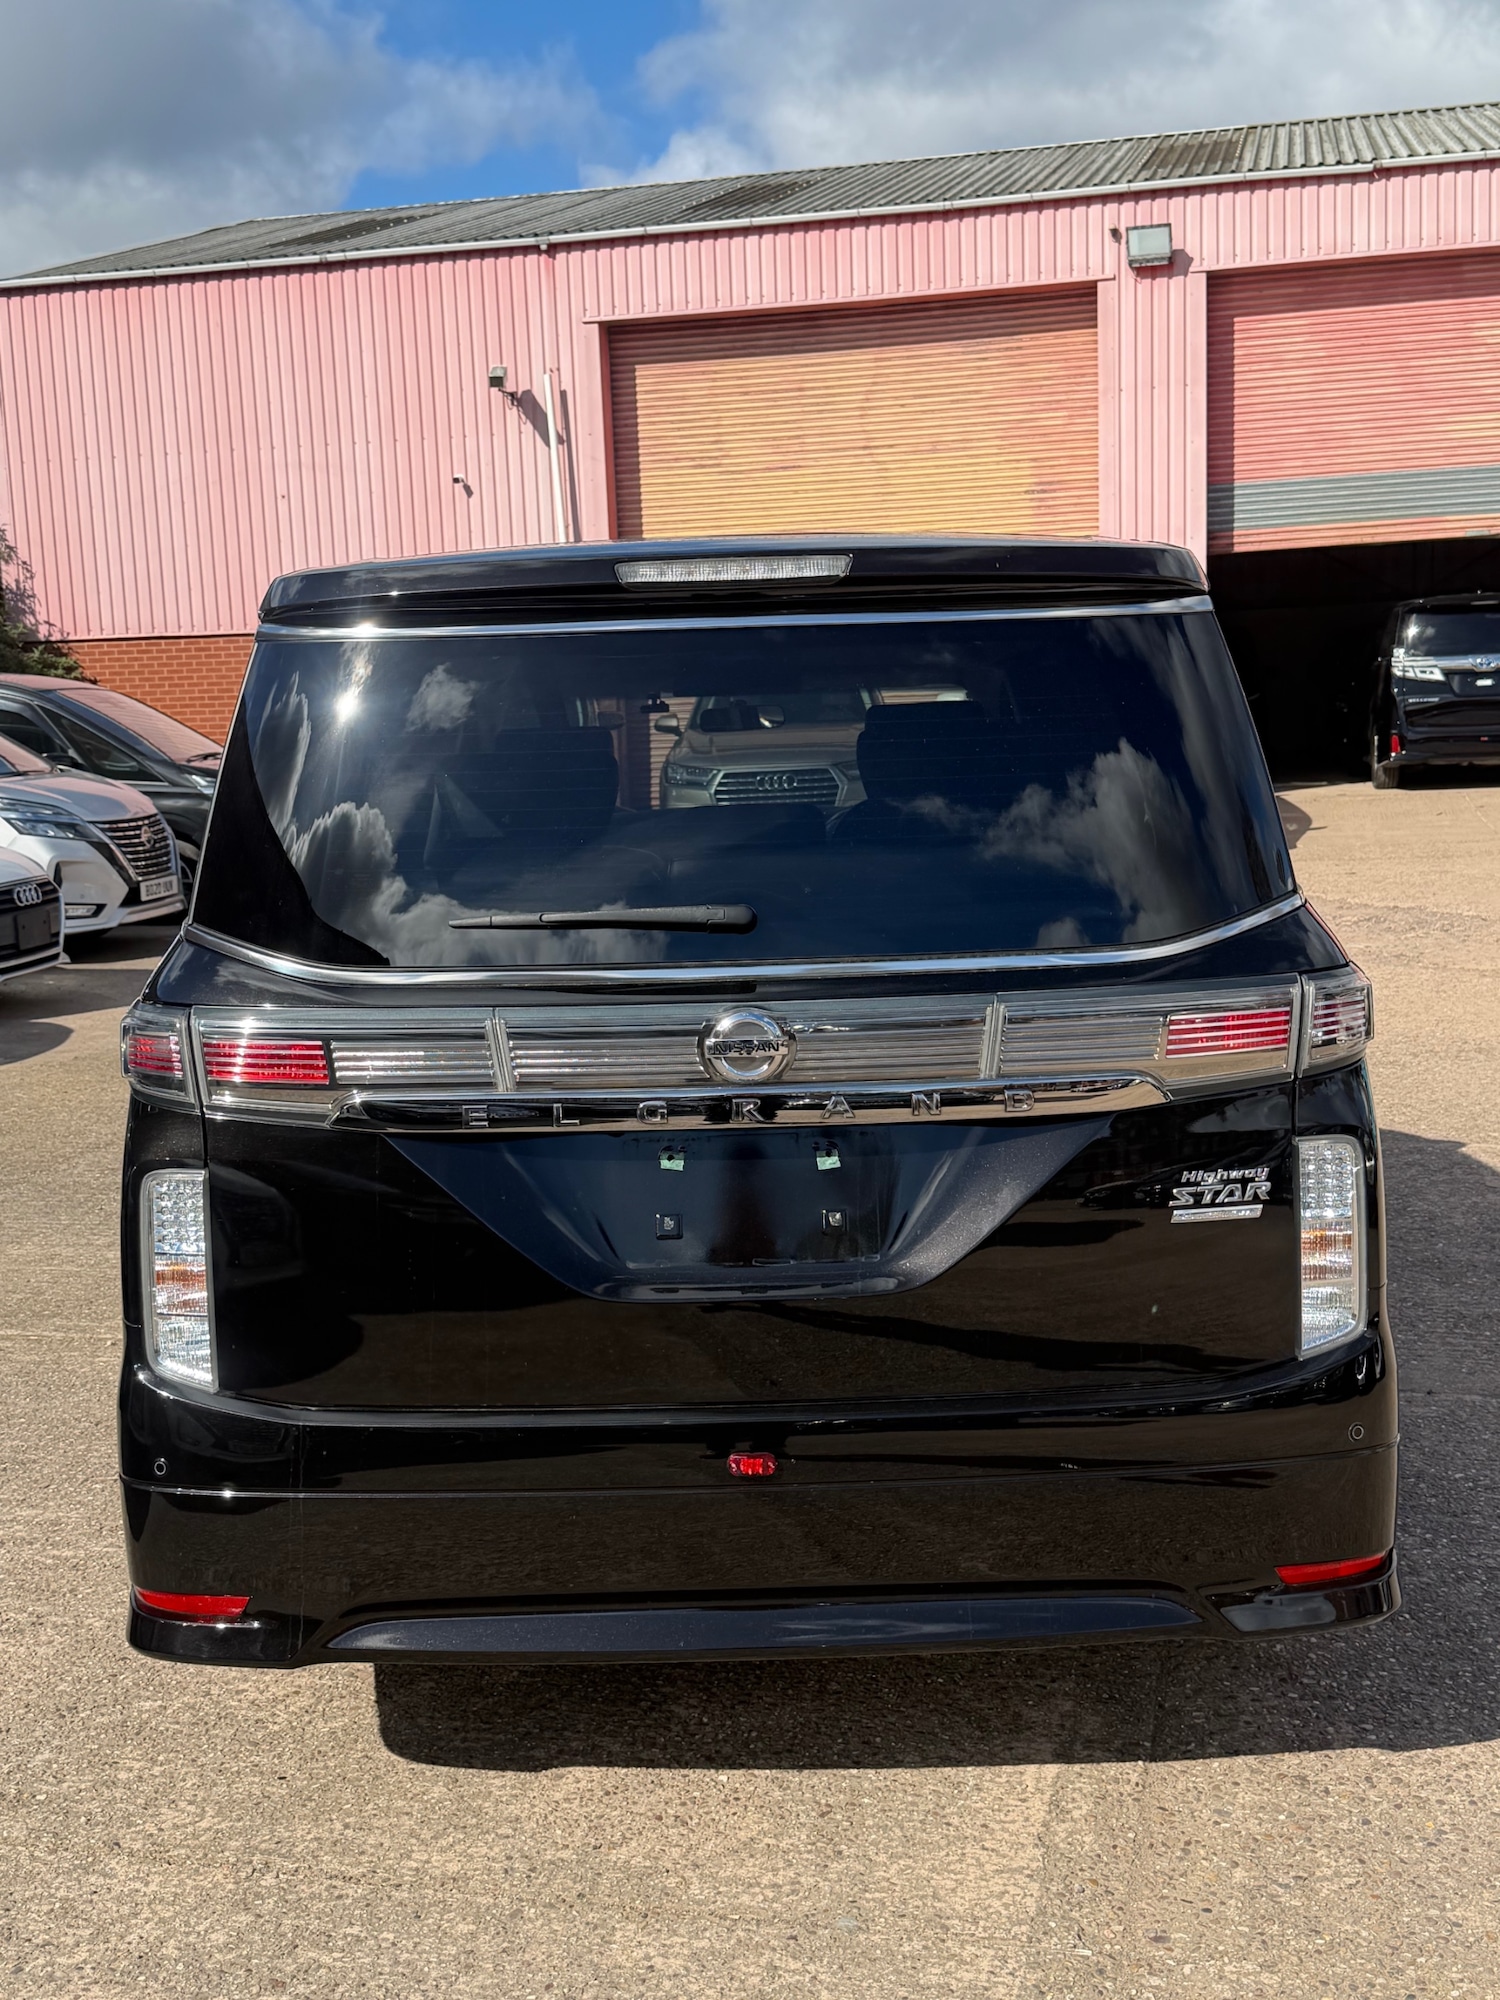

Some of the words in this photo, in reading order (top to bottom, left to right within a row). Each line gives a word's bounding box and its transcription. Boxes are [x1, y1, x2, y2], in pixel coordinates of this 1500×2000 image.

[714, 1041, 779, 1056] NISSAN
[462, 1088, 1035, 1128] ELGRAND
[1181, 1167, 1270, 1186] Highway
[1168, 1181, 1272, 1207] STAR
